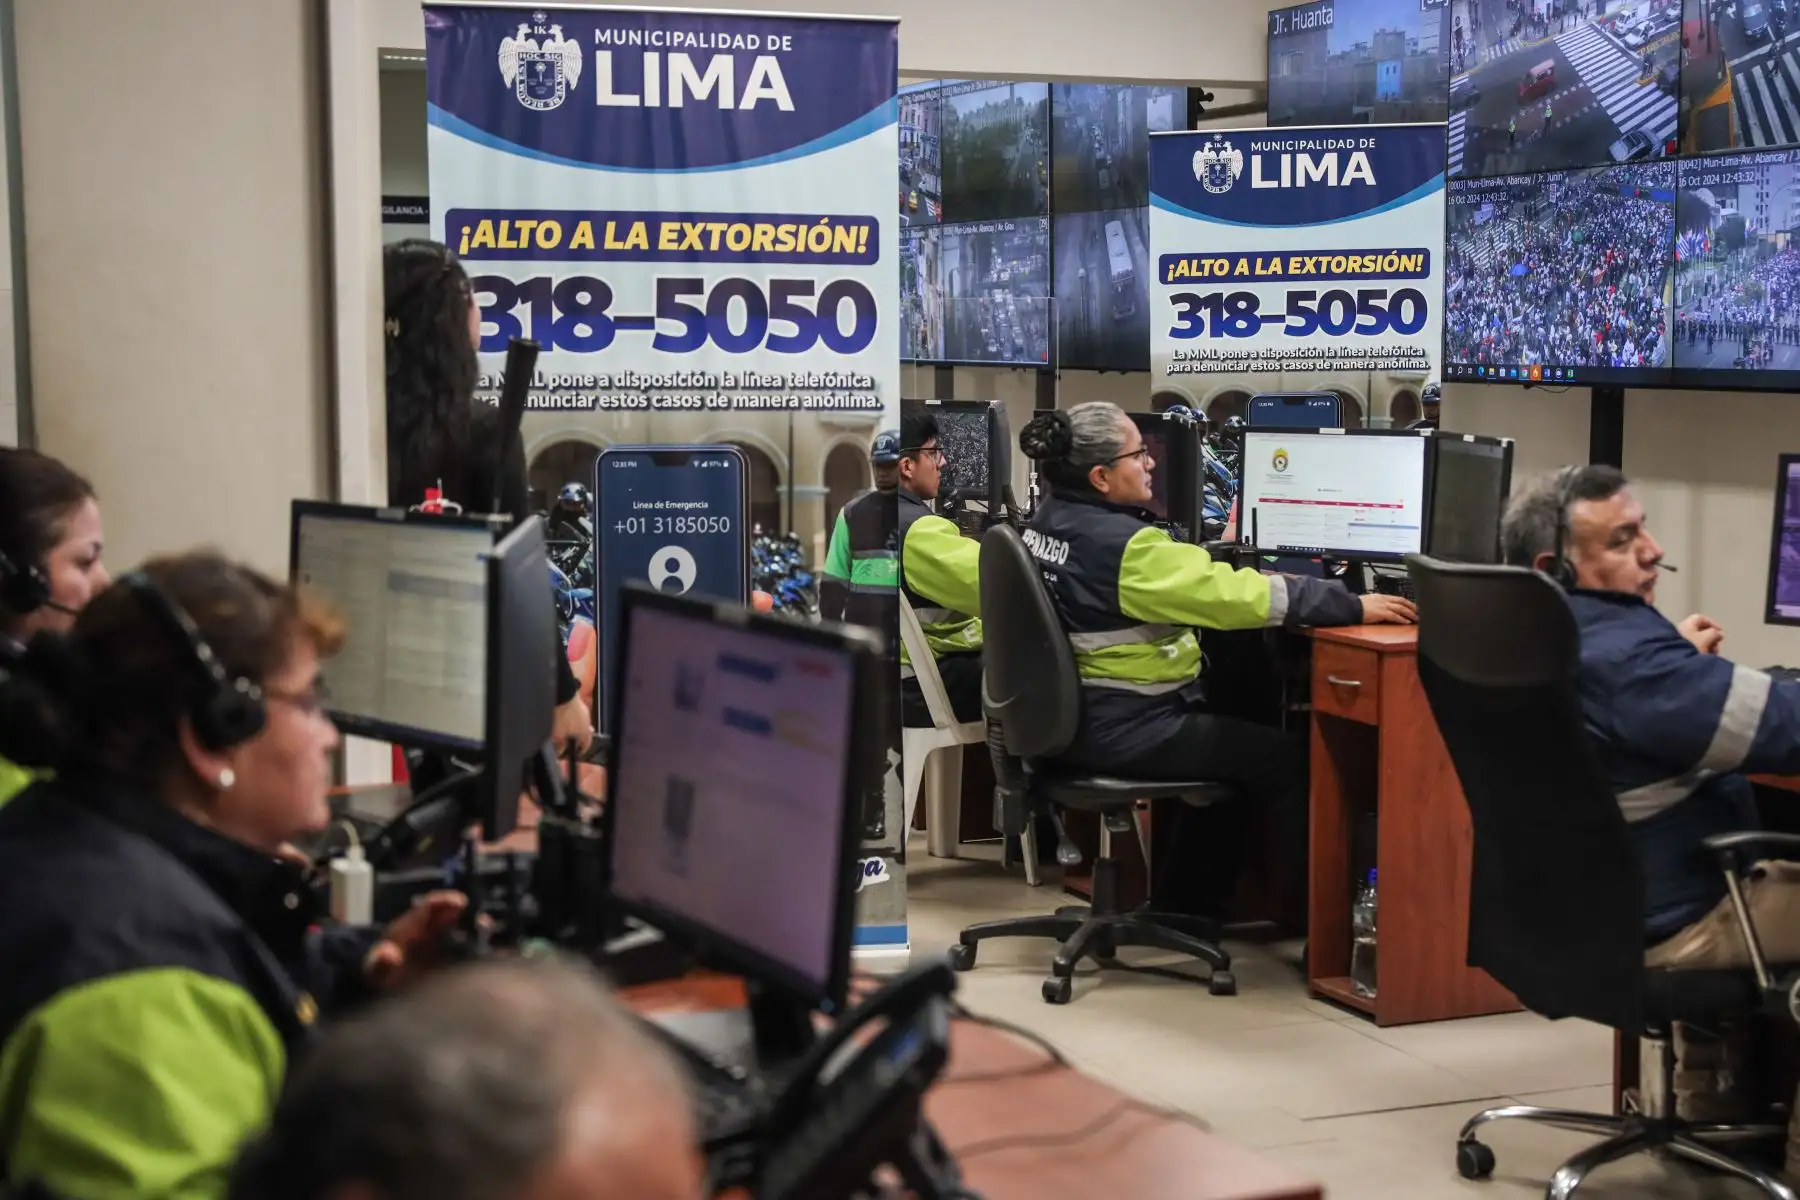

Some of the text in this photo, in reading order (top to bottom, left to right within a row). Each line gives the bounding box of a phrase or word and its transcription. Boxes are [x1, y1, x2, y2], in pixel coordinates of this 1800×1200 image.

[533, 25, 547, 35] IK
[1273, 6, 1334, 35] Jr. Huanta
[594, 28, 793, 51] MUNICIPALIDAD DE
[595, 50, 796, 112] LIMA
[1251, 138, 1376, 152] MUNICIPALIDAD DE
[1251, 151, 1377, 189] LIMA
[1678, 159, 1701, 171] [0042]
[1702, 155, 1752, 168] Mun-Lima-Av.
[1754, 152, 1788, 164] Abancay
[1506, 175, 1531, 186] Abancay
[1688, 176, 1700, 186] Oct
[1702, 174, 1720, 185] 2024
[1722, 171, 1755, 184] 12:43:32
[1455, 195, 1466, 204] Oct
[1466, 194, 1480, 204] 2024
[458, 217, 870, 255] ¡ALTO A LA EXTORSIÓN!
[1167, 250, 1424, 282] ¡ALTO A LA EXTORSIÓN!
[476, 274, 878, 355] 318-5050
[1168, 287, 1428, 340] 318-5050
[1172, 345, 1424, 362] La MML pone a disposición la línea telefónica
[1166, 357, 1430, 374] para denunciar estos casos de manera anónima.
[478, 373, 490, 388] a
[549, 373, 595, 390] pone
[599, 374, 610, 387] a
[614, 370, 715, 389] disposición
[720, 371, 735, 388] la
[740, 371, 782, 388] línea
[788, 371, 872, 388] telefónica
[524, 391, 595, 409] nunciar
[599, 393, 648, 409] estos
[652, 395, 701, 409] casos
[706, 391, 728, 408] de
[733, 395, 799, 409] manera
[803, 390, 881, 409] anónima.
[654, 501, 665, 509] de
[665, 501, 709, 510] Emergencia
[613, 516, 731, 534] +01 3185050
